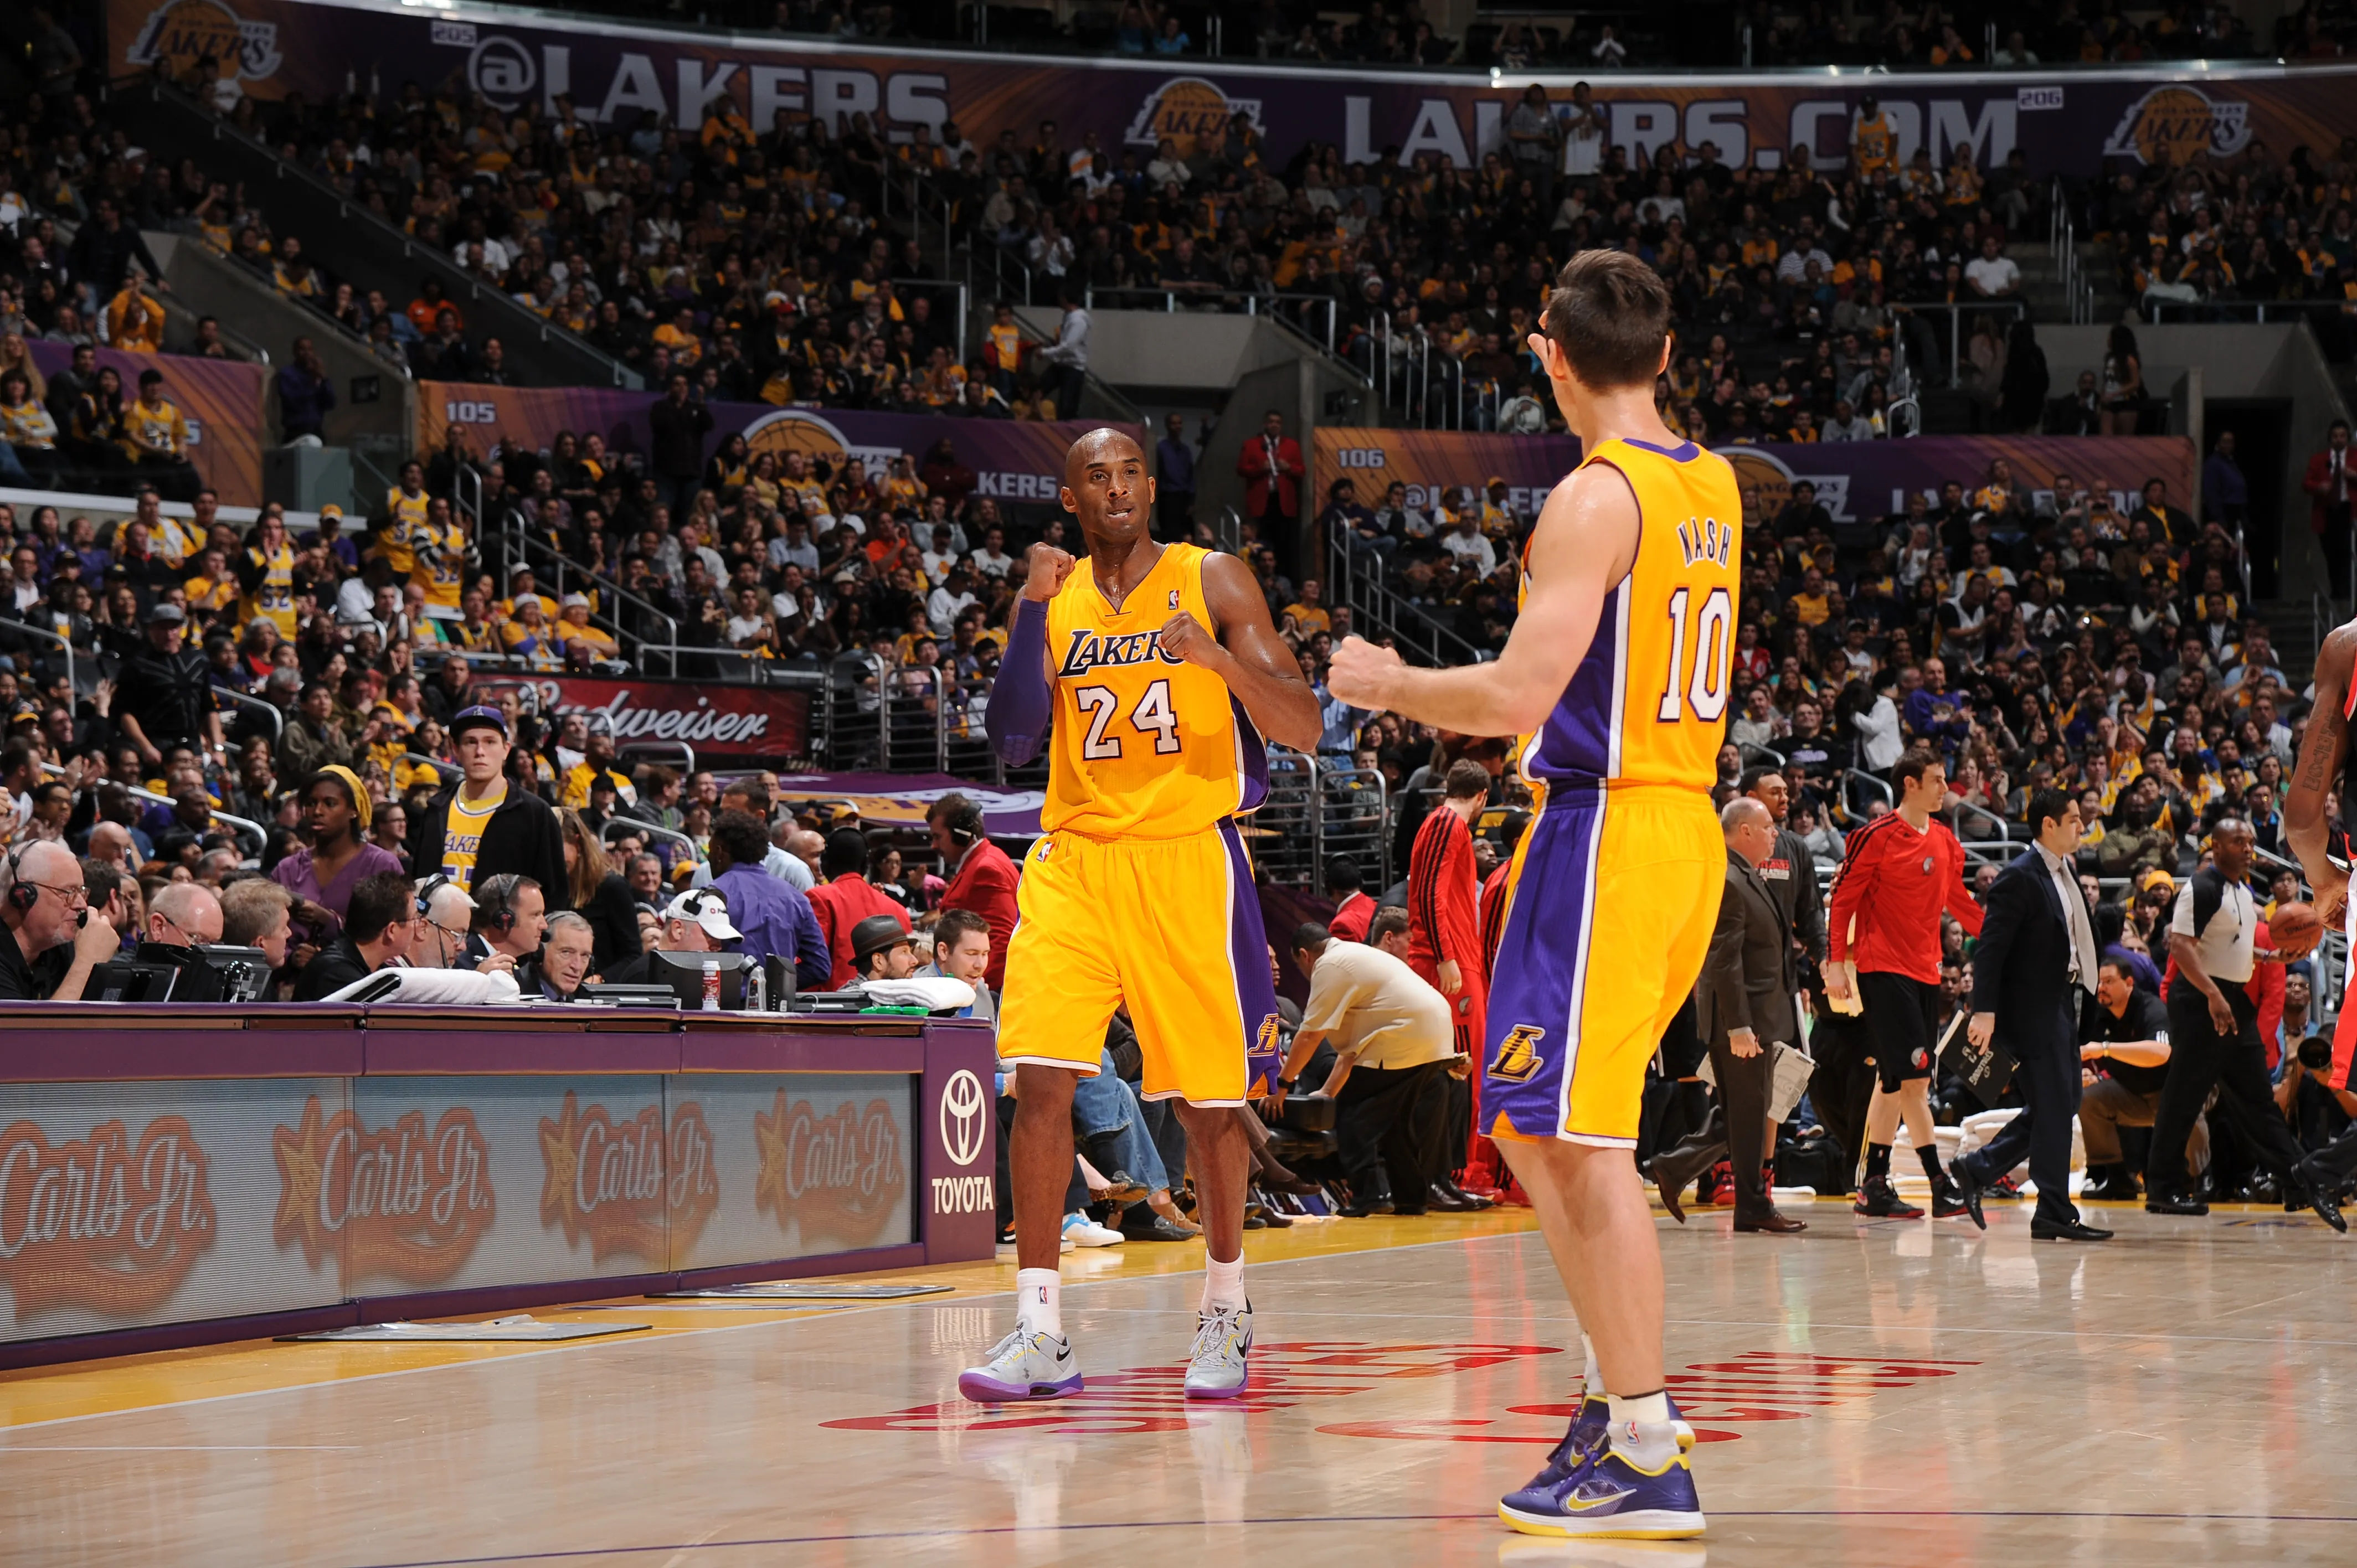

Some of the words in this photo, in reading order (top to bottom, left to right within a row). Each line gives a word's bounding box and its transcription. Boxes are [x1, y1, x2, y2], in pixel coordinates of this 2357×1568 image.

[2019, 89, 2062, 107] 206
[446, 402, 497, 424] 105
[1338, 448, 1385, 468] 106
[1677, 517, 1732, 568] NASH
[1657, 587, 1732, 723] 10
[1074, 679, 1182, 761] 24
[0, 1133, 132, 1258] Carl's
[135, 1134, 208, 1249] Jr.
[320, 1121, 430, 1231] Carl's
[433, 1125, 488, 1225] Jr.
[576, 1116, 663, 1214] Carl's
[672, 1116, 714, 1210] Jr.
[785, 1113, 857, 1199] Carl's
[860, 1112, 900, 1196] Jr.
[932, 1177, 994, 1214] TOYOTA
